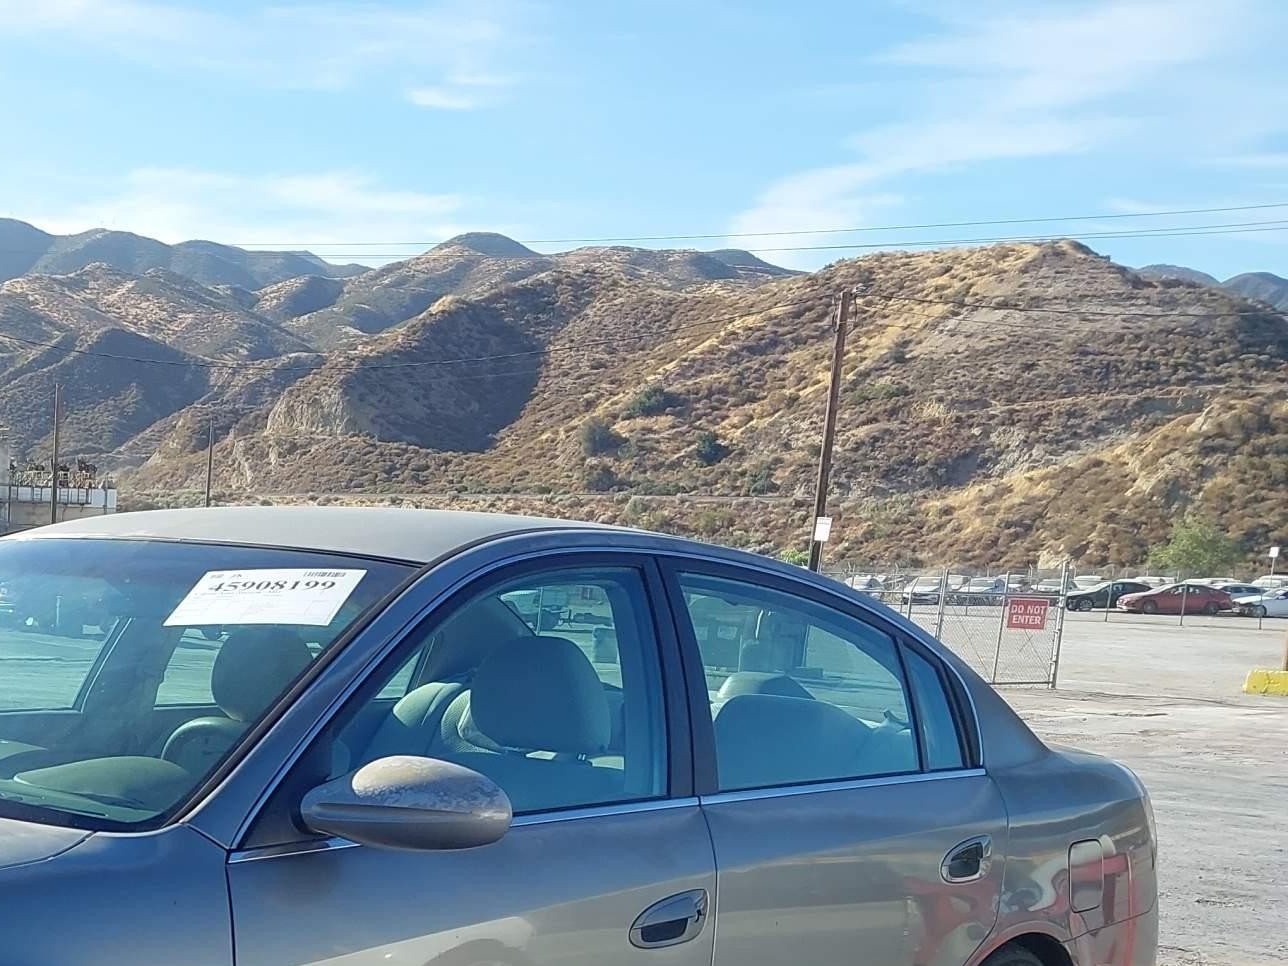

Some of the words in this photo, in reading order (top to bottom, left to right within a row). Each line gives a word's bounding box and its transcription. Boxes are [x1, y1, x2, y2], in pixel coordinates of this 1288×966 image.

[208, 580, 337, 593] 45908199
[1010, 604, 1024, 614] DO
[1026, 605, 1046, 615] NOT
[1012, 615, 1042, 625] ENTER
